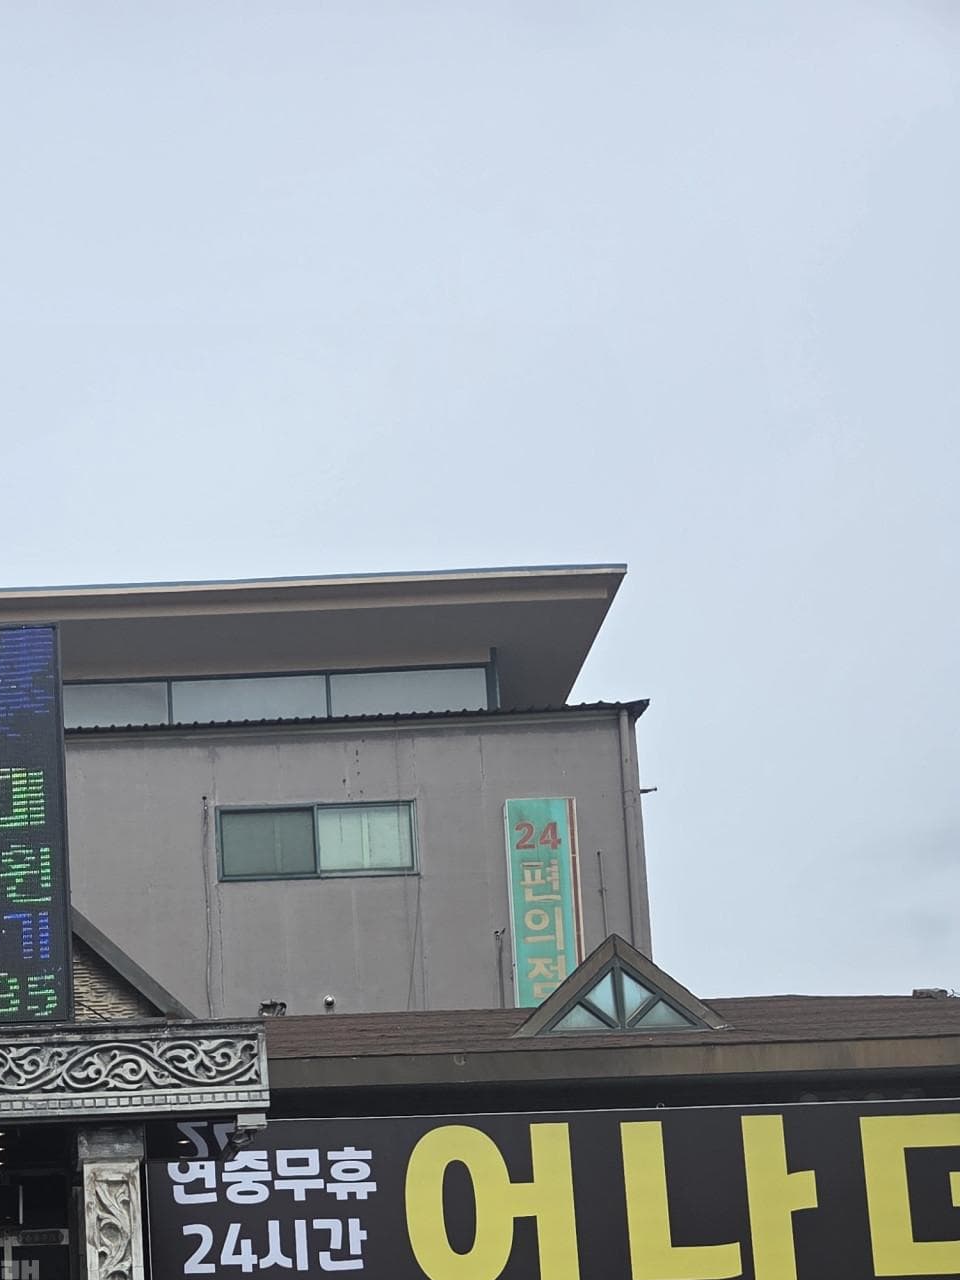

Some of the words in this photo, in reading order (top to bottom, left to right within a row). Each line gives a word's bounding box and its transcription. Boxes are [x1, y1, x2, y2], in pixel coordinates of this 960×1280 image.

[514, 821, 562, 850] 24
[520, 859, 568, 999] 편의점
[167, 1146, 377, 1205] 연중무휴
[182, 1218, 368, 1275] 24시간
